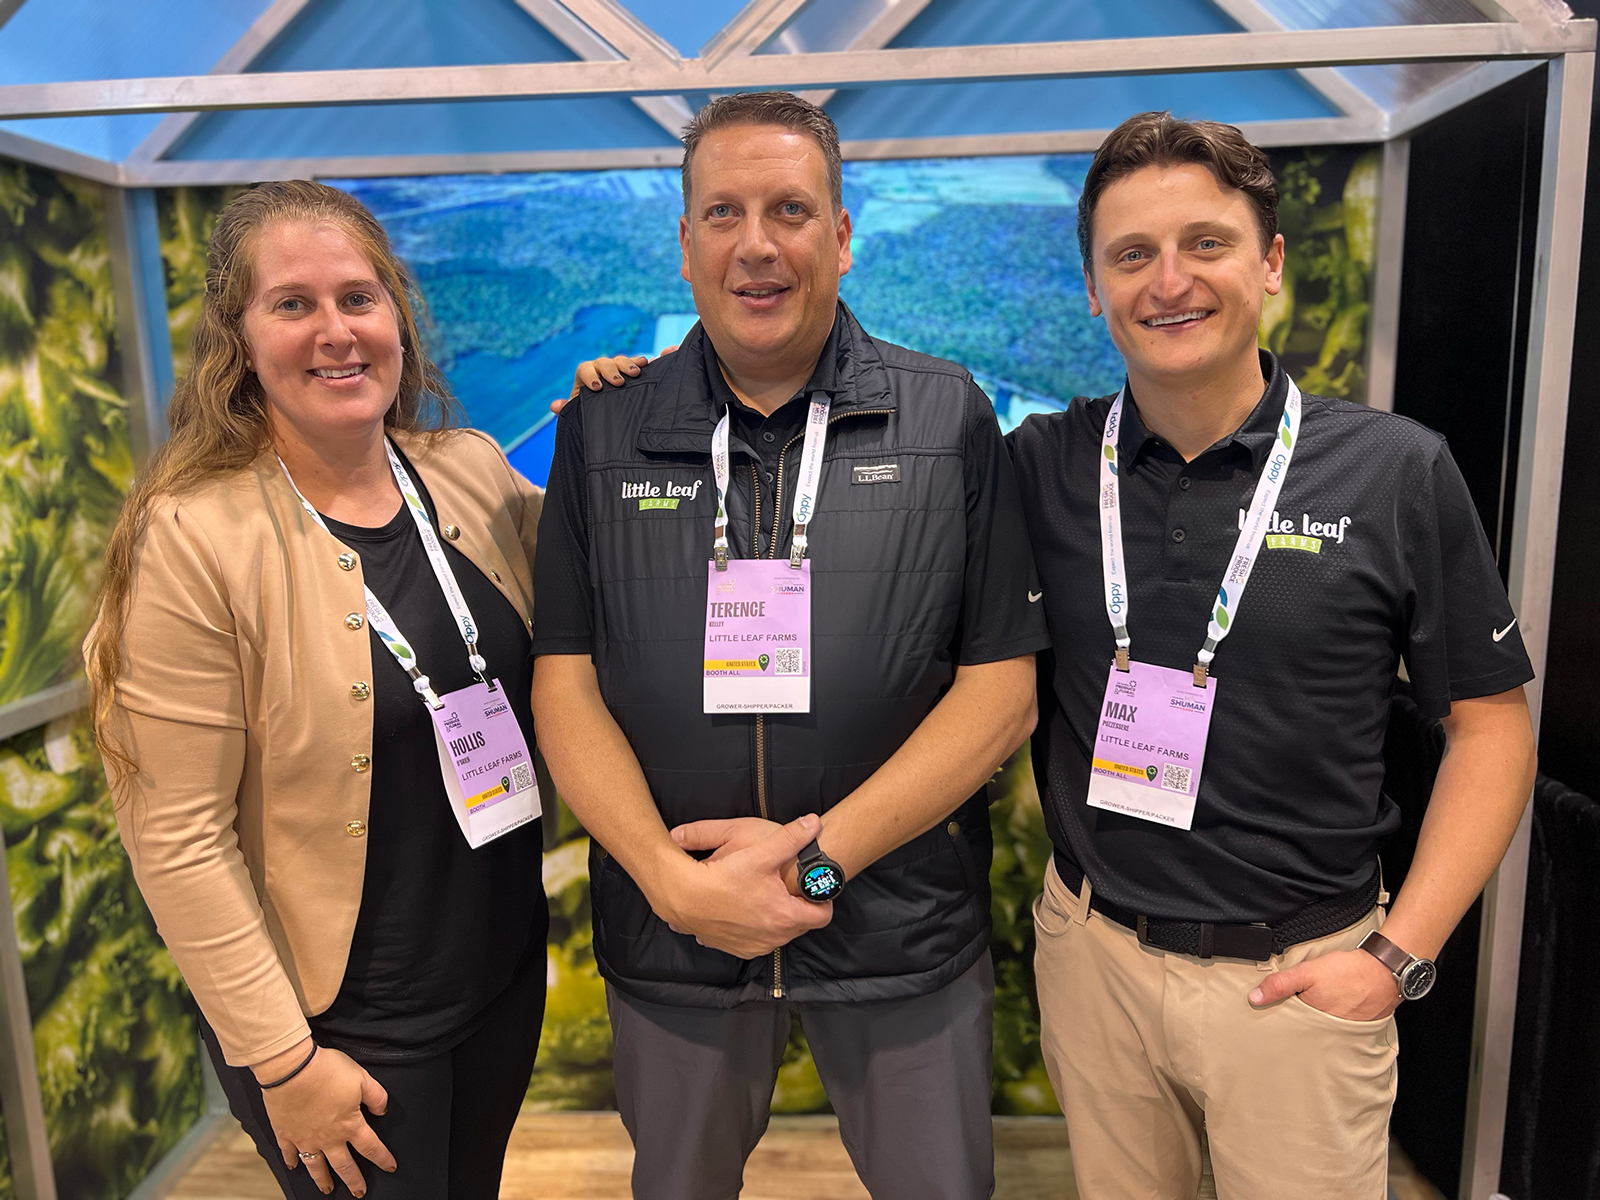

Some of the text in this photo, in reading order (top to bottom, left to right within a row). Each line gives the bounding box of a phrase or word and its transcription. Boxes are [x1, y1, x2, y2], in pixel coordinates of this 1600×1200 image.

[1106, 412, 1118, 438] Oppy
[392, 461, 409, 487] Oppy
[1267, 454, 1286, 484] Oppy
[622, 480, 702, 500] little leaf
[1261, 490, 1271, 506] Expect
[797, 494, 811, 522] Oppy
[1238, 508, 1351, 544] lle leaf
[1254, 516, 1262, 530] world
[1270, 537, 1316, 550] FARMS
[1228, 556, 1243, 584] PRODUCE
[1238, 558, 1250, 577] FRESH
[1111, 582, 1124, 614] Oppy
[710, 601, 765, 618] TERENCE
[460, 615, 475, 644] Oppy
[484, 704, 508, 717] SHUMAN
[1105, 701, 1138, 723] MAX
[1170, 699, 1206, 711] SHUMAN
[449, 731, 486, 757] HOLLIS
[1100, 734, 1189, 760] LITTLE LEAF FARMS
[462, 751, 523, 781] LITTLE LEAF FARMS
[1094, 767, 1115, 776] BOOTH
[1129, 767, 1144, 775] STATES
[470, 804, 486, 814] BOOTH
